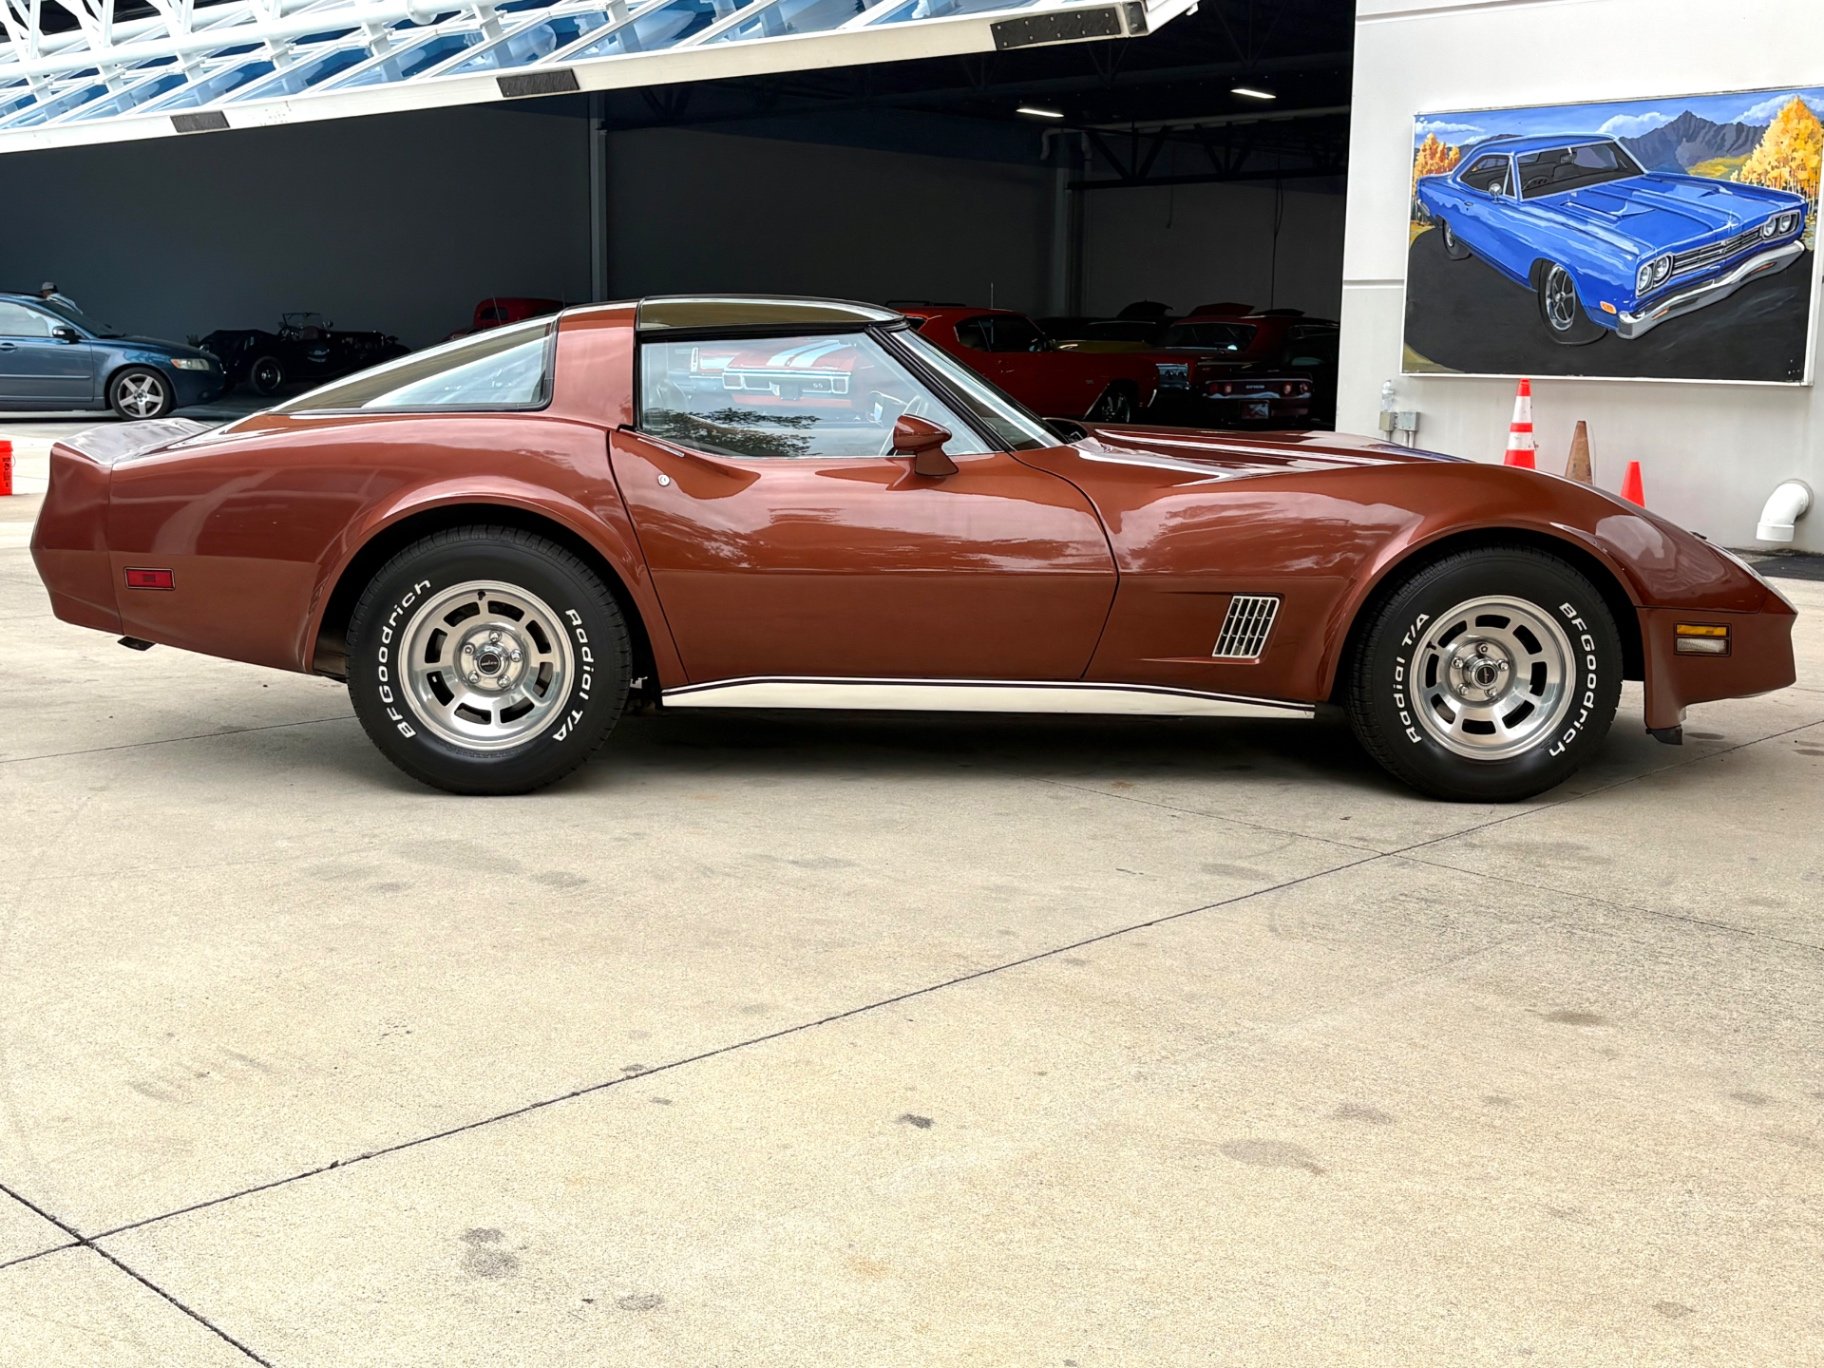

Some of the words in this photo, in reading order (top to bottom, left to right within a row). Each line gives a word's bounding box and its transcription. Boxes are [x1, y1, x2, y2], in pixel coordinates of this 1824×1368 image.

[378, 579, 431, 739] BFGoodrich
[565, 608, 594, 700] Radial
[1402, 613, 1430, 647] T/A
[1393, 656, 1422, 743] Radial
[1549, 602, 1597, 757] BFGoodrich
[552, 708, 583, 742] T/A
